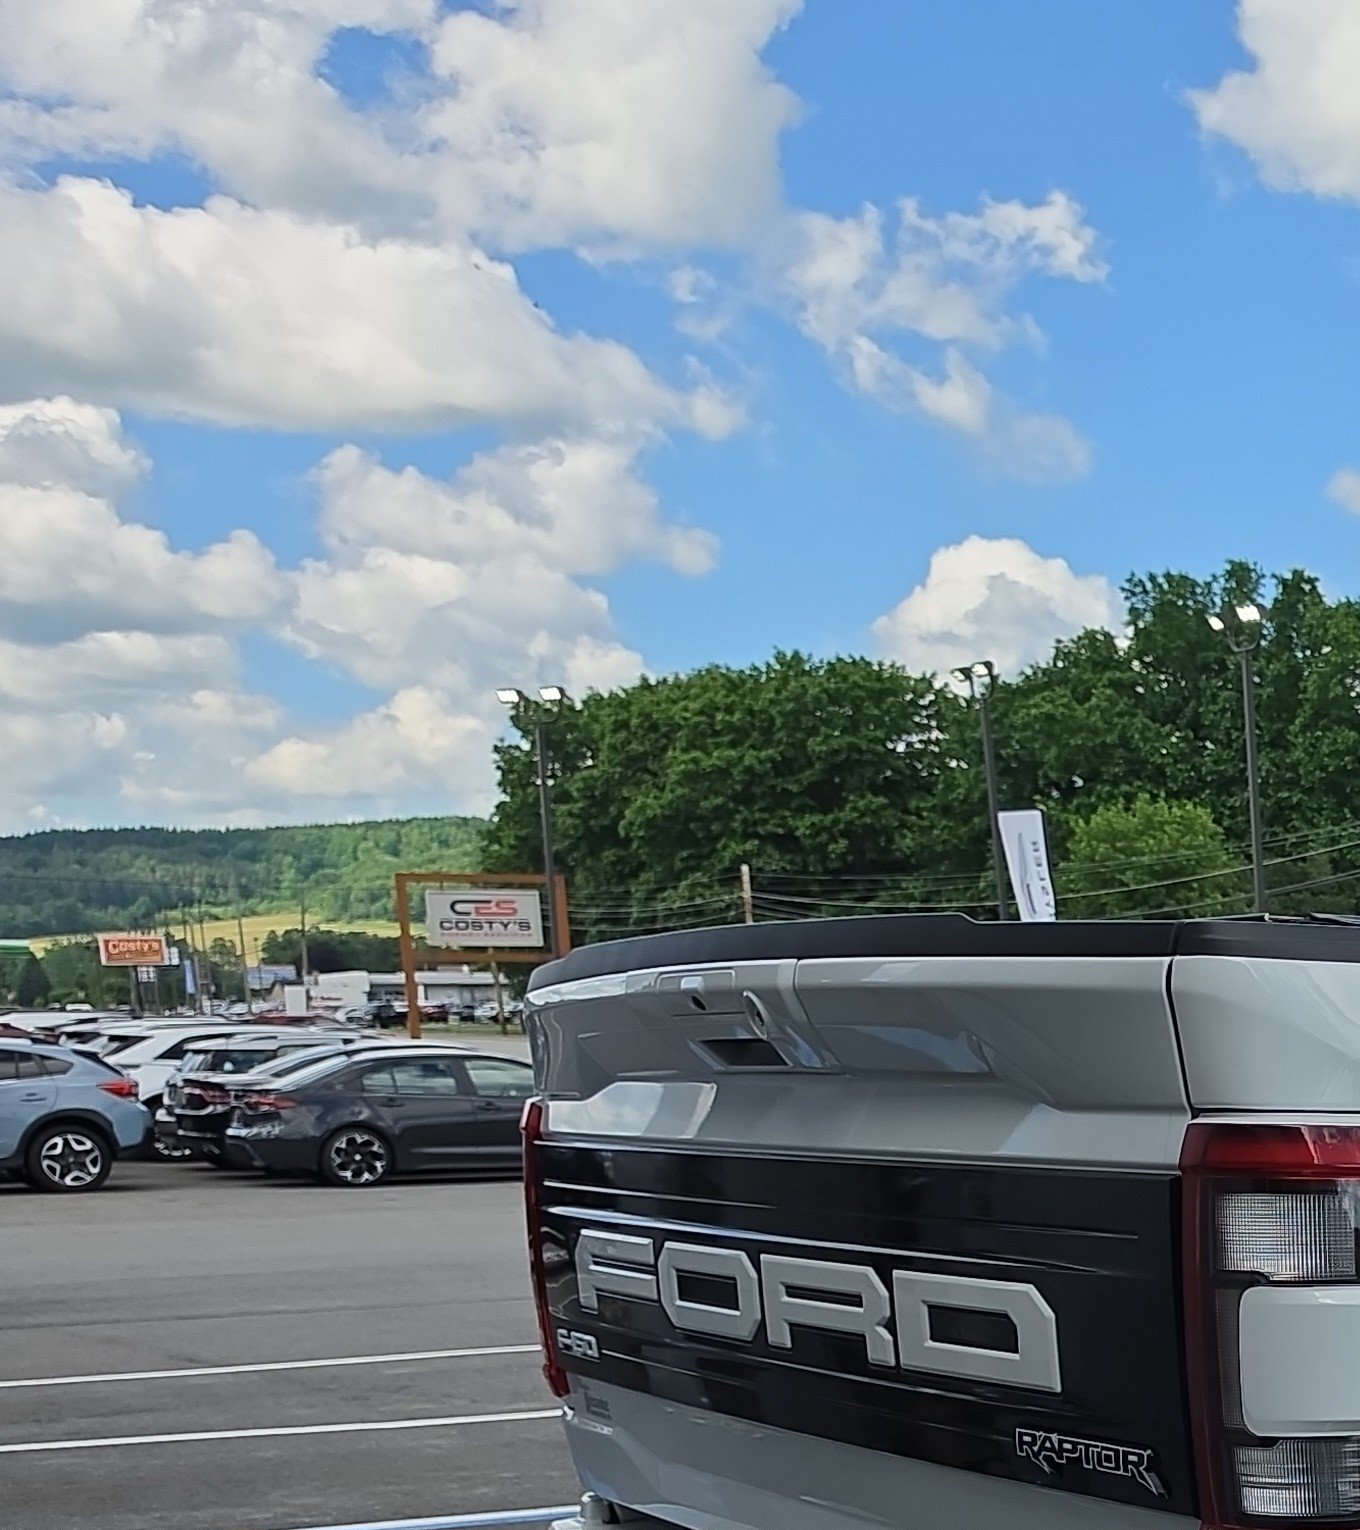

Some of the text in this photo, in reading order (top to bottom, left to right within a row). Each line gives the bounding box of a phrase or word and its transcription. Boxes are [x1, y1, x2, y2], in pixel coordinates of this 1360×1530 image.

[440, 920, 531, 932] COSTY'S
[108, 941, 159, 954] Costy's
[575, 1229, 1063, 1393] FORD
[1016, 1428, 1159, 1496] RAPTOR
